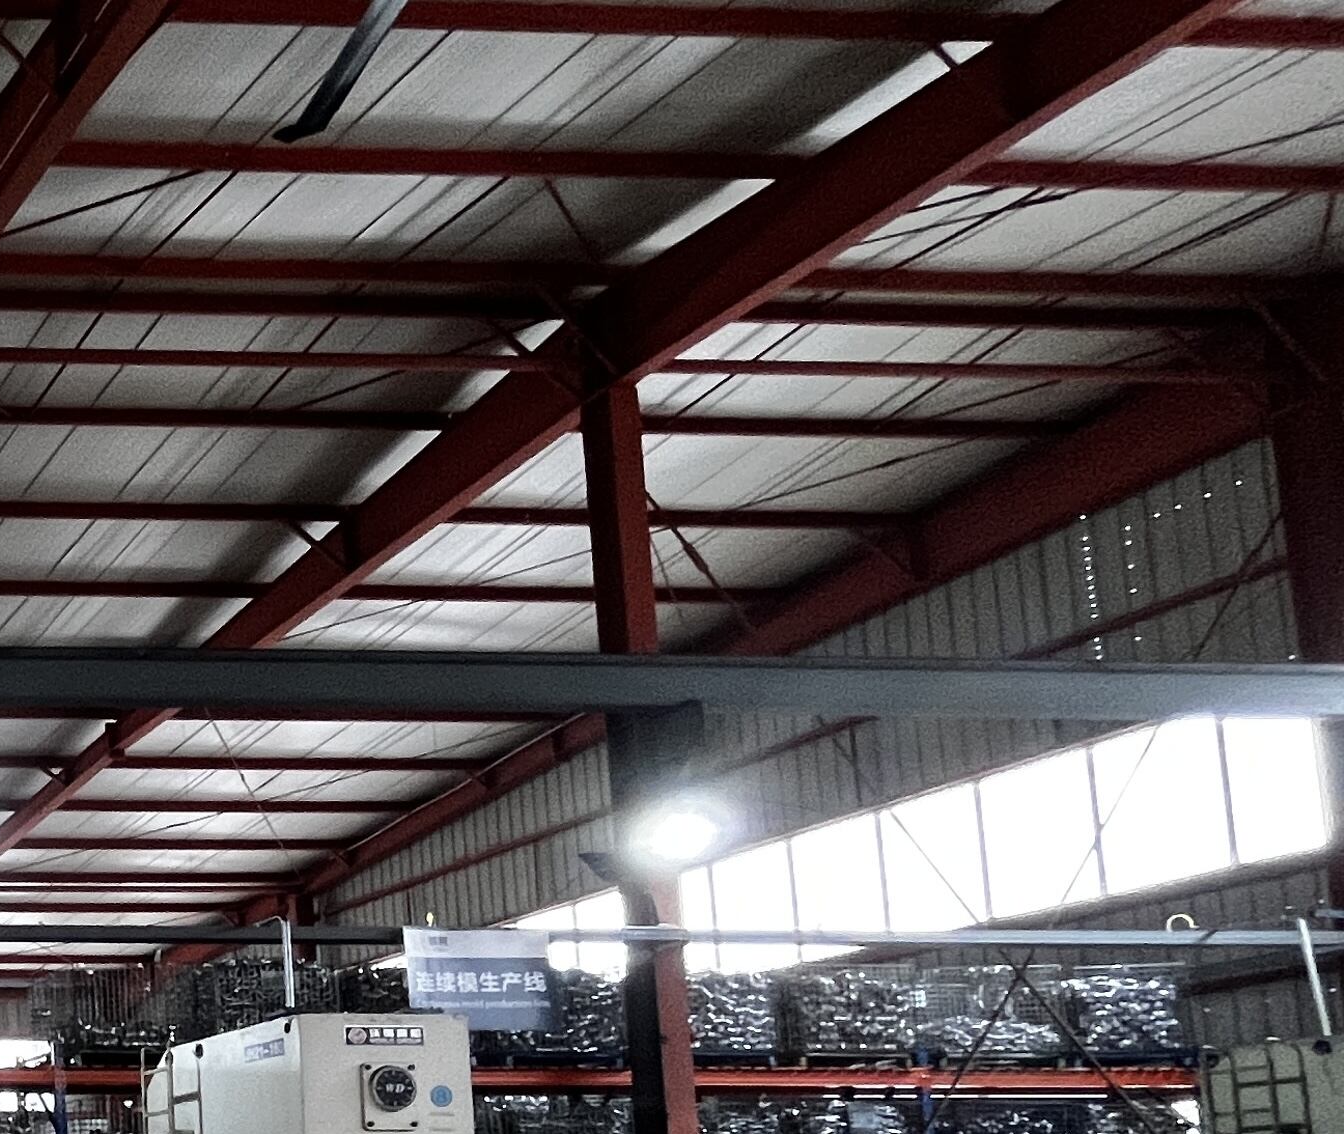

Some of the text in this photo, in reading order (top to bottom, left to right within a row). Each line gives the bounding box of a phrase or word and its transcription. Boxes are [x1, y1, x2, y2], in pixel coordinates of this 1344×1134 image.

[415, 970, 548, 993] 连续模生产线
